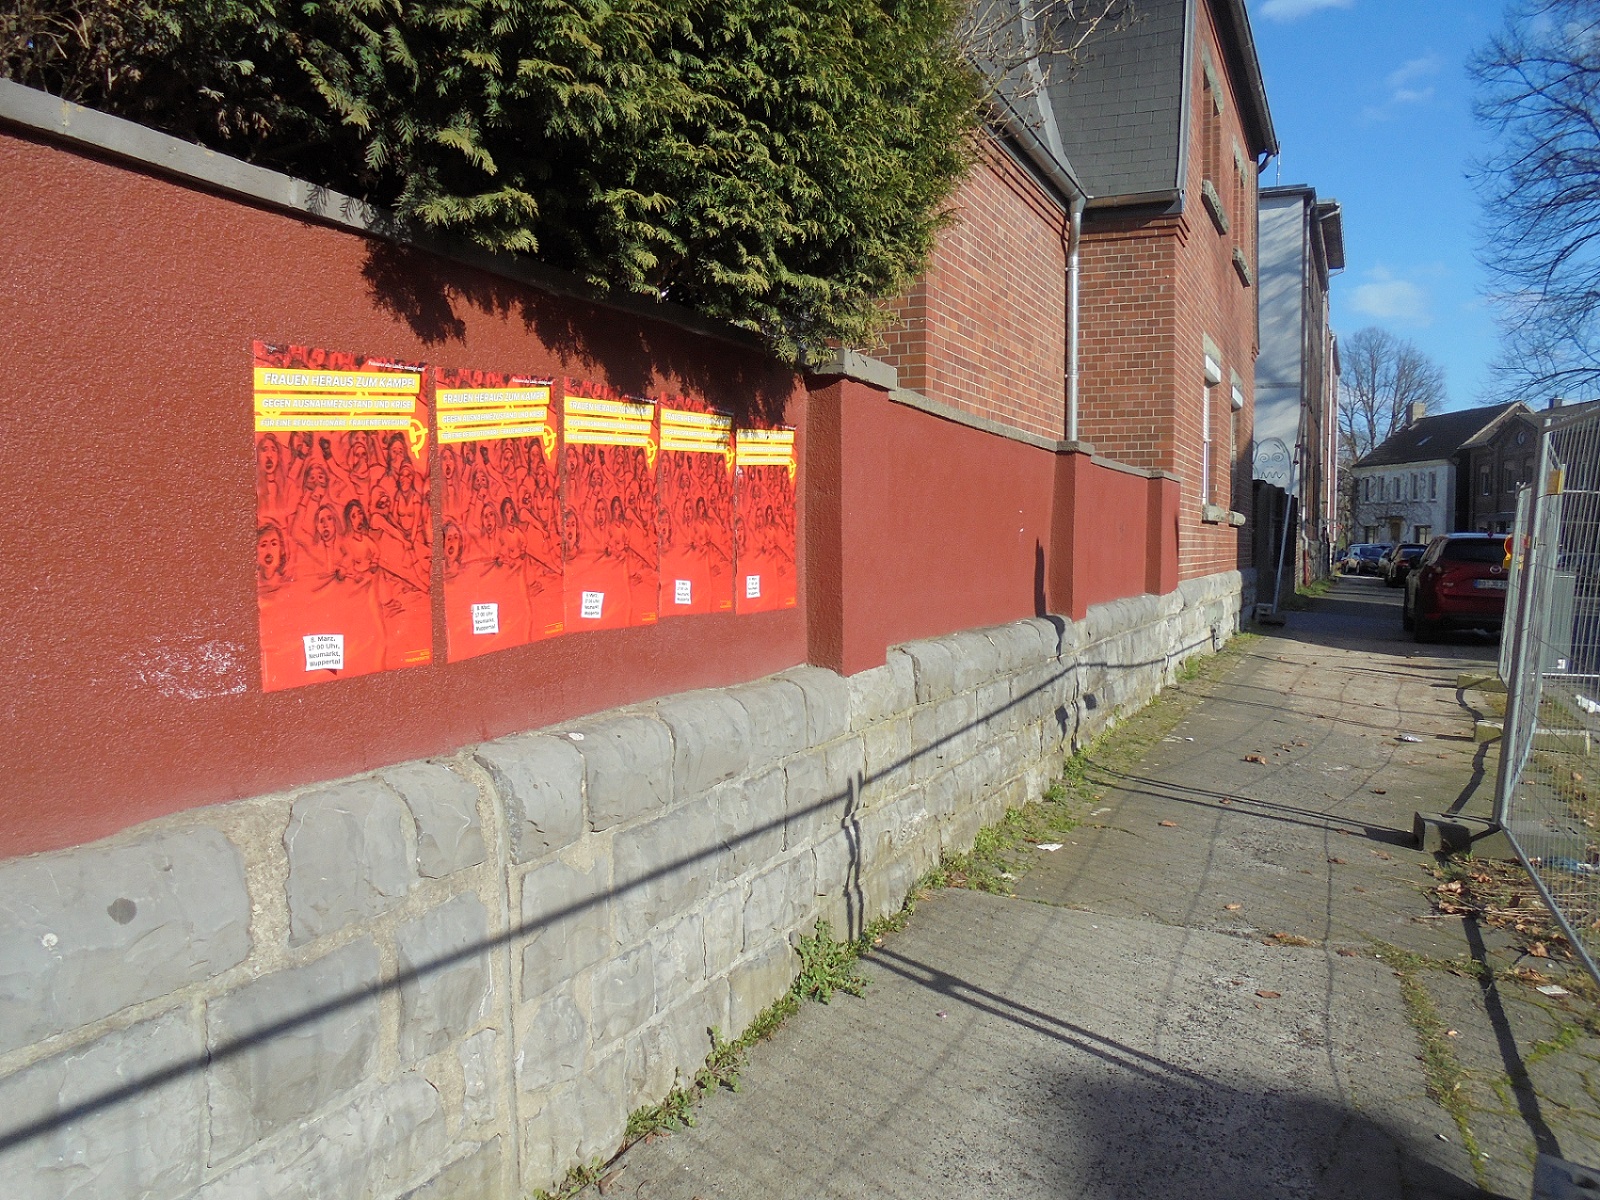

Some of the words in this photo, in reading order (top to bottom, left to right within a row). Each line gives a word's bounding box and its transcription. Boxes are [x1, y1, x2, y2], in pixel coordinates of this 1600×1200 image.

[263, 373, 309, 386] FRAUEN
[311, 375, 354, 387] HERAUS
[356, 376, 378, 388] ZUM
[378, 378, 416, 389] KAMPF!
[443, 393, 474, 404] FRAUEN
[475, 392, 503, 403] HERAUS
[504, 392, 520, 402] ZUM
[262, 399, 290, 408] GEGEN
[292, 400, 372, 409] AUSNAHMEZUSTAND
[374, 400, 389, 409] UND
[260, 418, 274, 426] FÜR
[309, 658, 341, 667] Wuppertal
